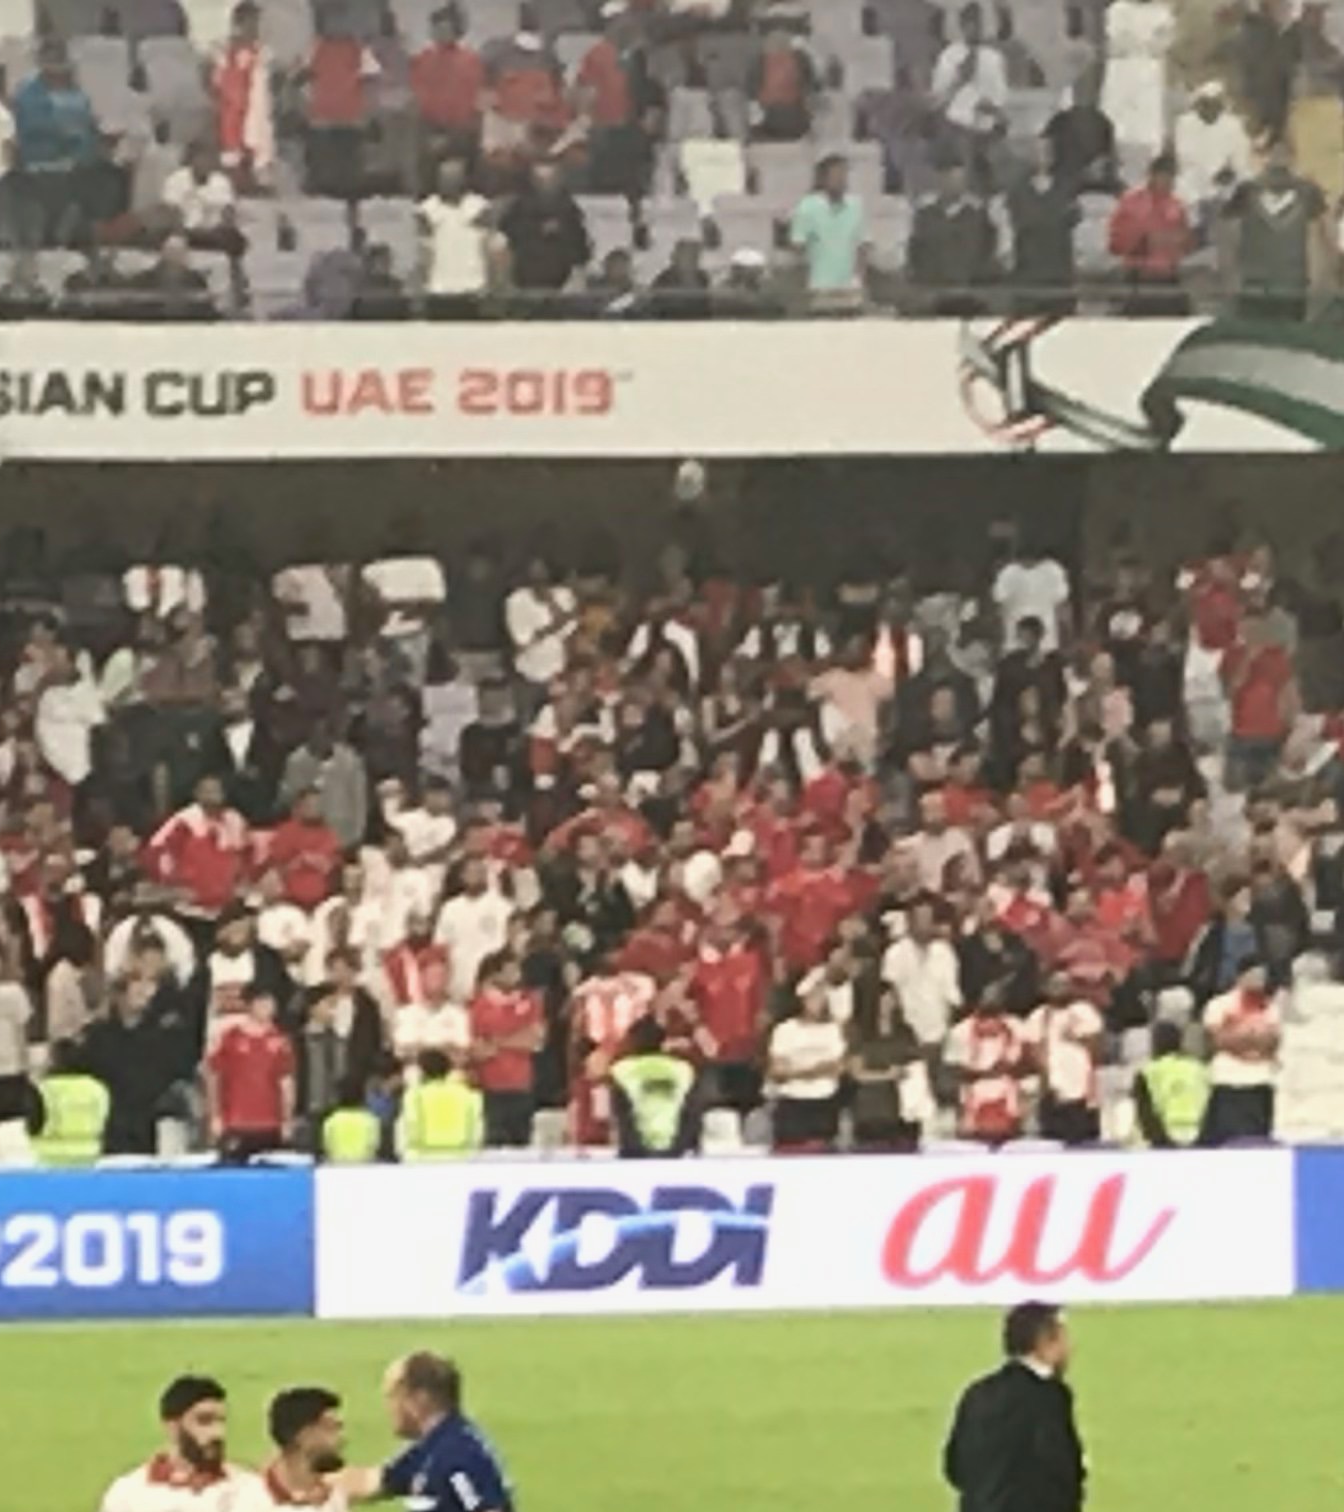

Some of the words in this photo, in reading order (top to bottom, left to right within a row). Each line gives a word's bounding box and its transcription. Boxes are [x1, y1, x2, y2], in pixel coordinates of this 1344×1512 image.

[144, 371, 275, 418] CUP
[301, 369, 433, 416] UAE
[457, 368, 616, 416] 2019
[456, 1184, 775, 1292] KDDI
[880, 1172, 1176, 1290] au
